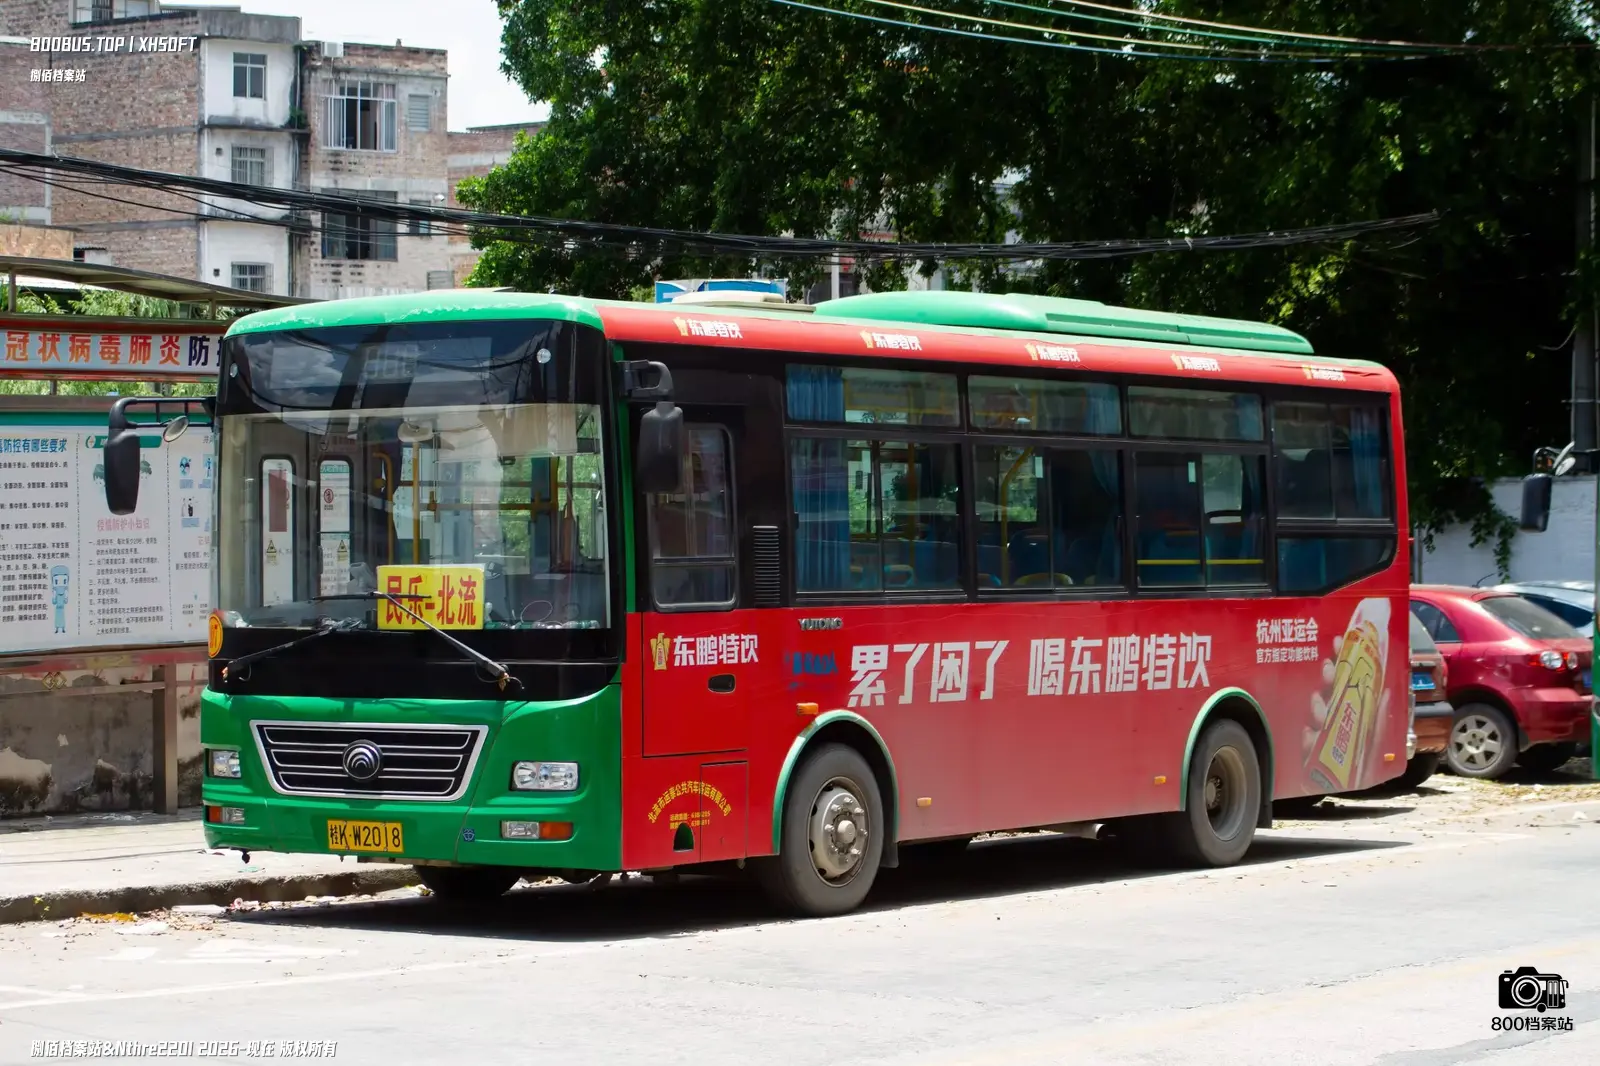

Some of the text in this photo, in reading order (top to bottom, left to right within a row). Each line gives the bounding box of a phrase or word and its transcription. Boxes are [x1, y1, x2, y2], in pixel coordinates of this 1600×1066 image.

[5, 330, 220, 367] 冠状病毒肺炎防
[385, 575, 477, 626] 民乐-北流
[797, 617, 844, 631] YUTONG
[1255, 616, 1319, 645] 杭州亚运会
[673, 633, 759, 667] 东鹏特饮
[1255, 646, 1320, 664] 官方指定功能饮料
[847, 632, 1212, 708] 累了困了 喝东鹏特饮
